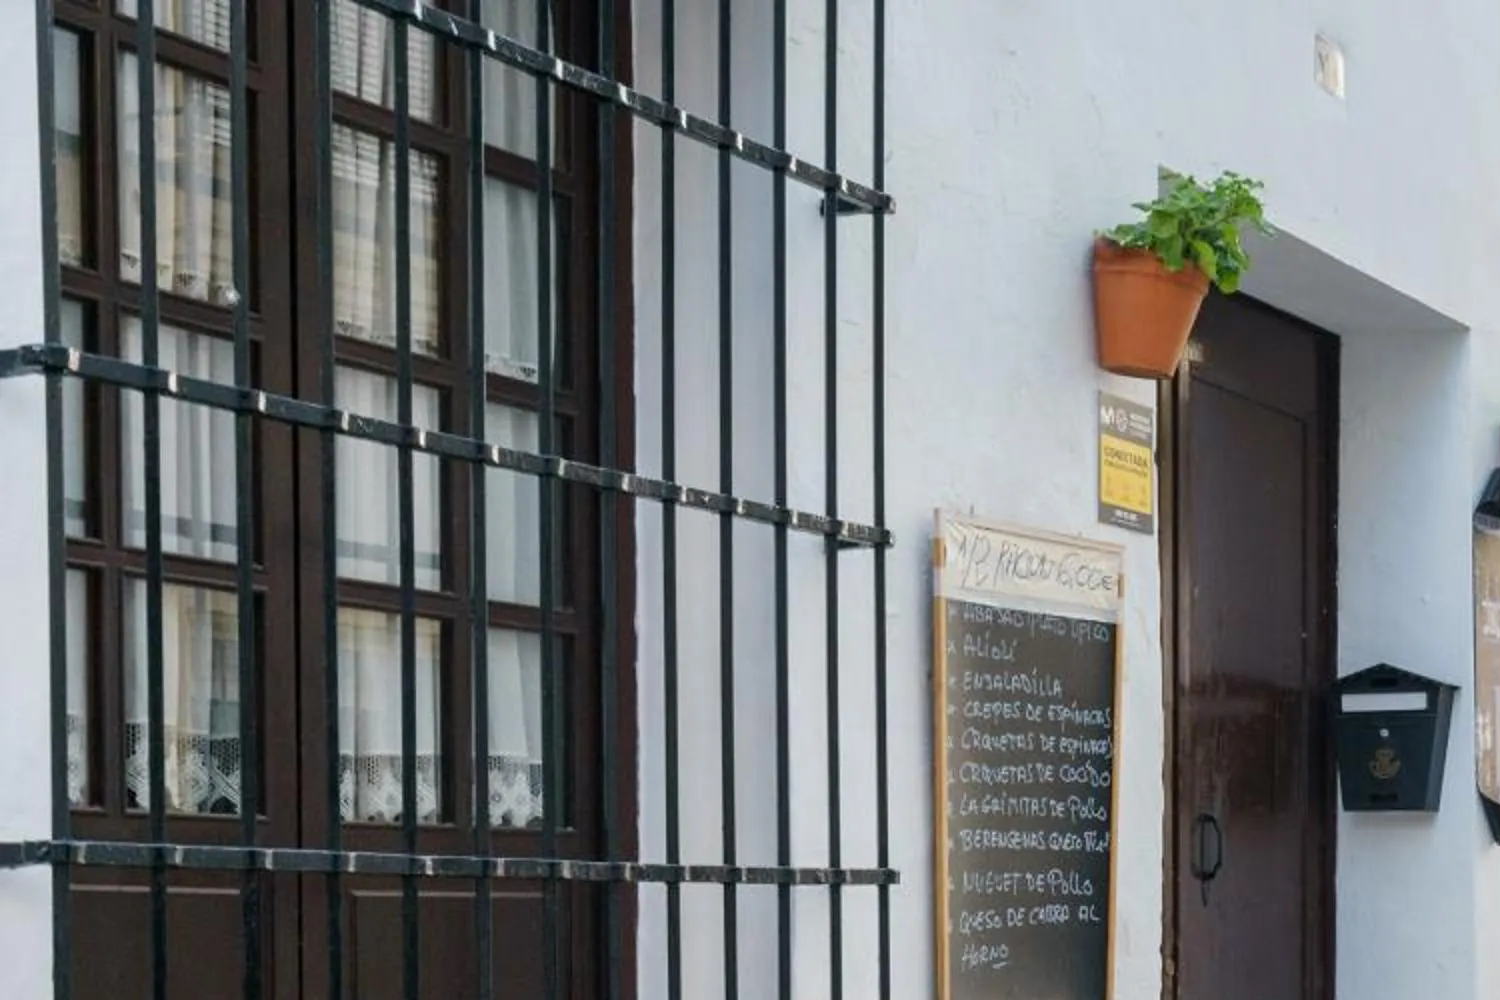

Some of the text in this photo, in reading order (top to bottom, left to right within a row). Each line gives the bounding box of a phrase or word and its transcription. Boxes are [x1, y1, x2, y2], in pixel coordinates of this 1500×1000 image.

[1026, 703, 1042, 722] DE
[1039, 732, 1057, 752] DE
[1035, 763, 1055, 783] DE
[1050, 799, 1065, 818] DE
[1025, 872, 1045, 893] DE
[1007, 907, 1026, 927] DE
[1078, 904, 1101, 922] AL
